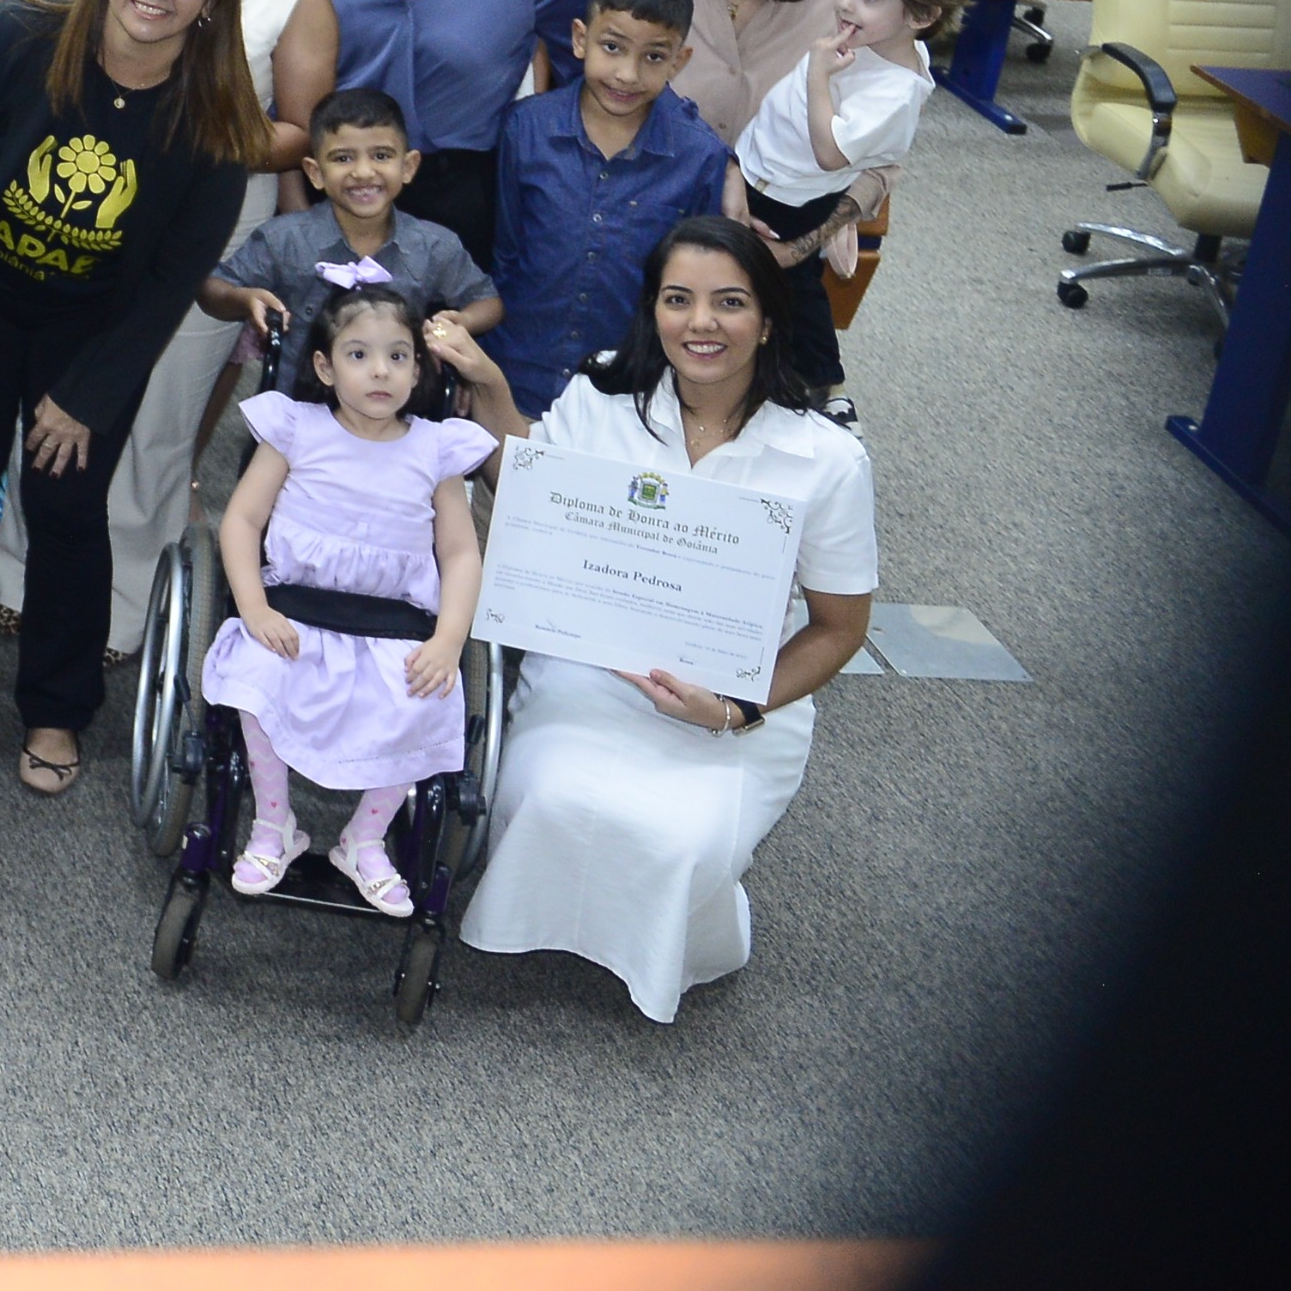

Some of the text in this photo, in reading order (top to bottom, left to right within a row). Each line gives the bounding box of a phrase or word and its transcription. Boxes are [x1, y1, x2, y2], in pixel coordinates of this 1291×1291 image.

[550, 491, 739, 545] Diploma de Honra ao Mérito
[565, 511, 605, 528] Câmara
[607, 520, 660, 543] Municipal
[663, 534, 673, 545] de
[583, 560, 629, 581] Izadora
[633, 571, 683, 593] Pedrosa
